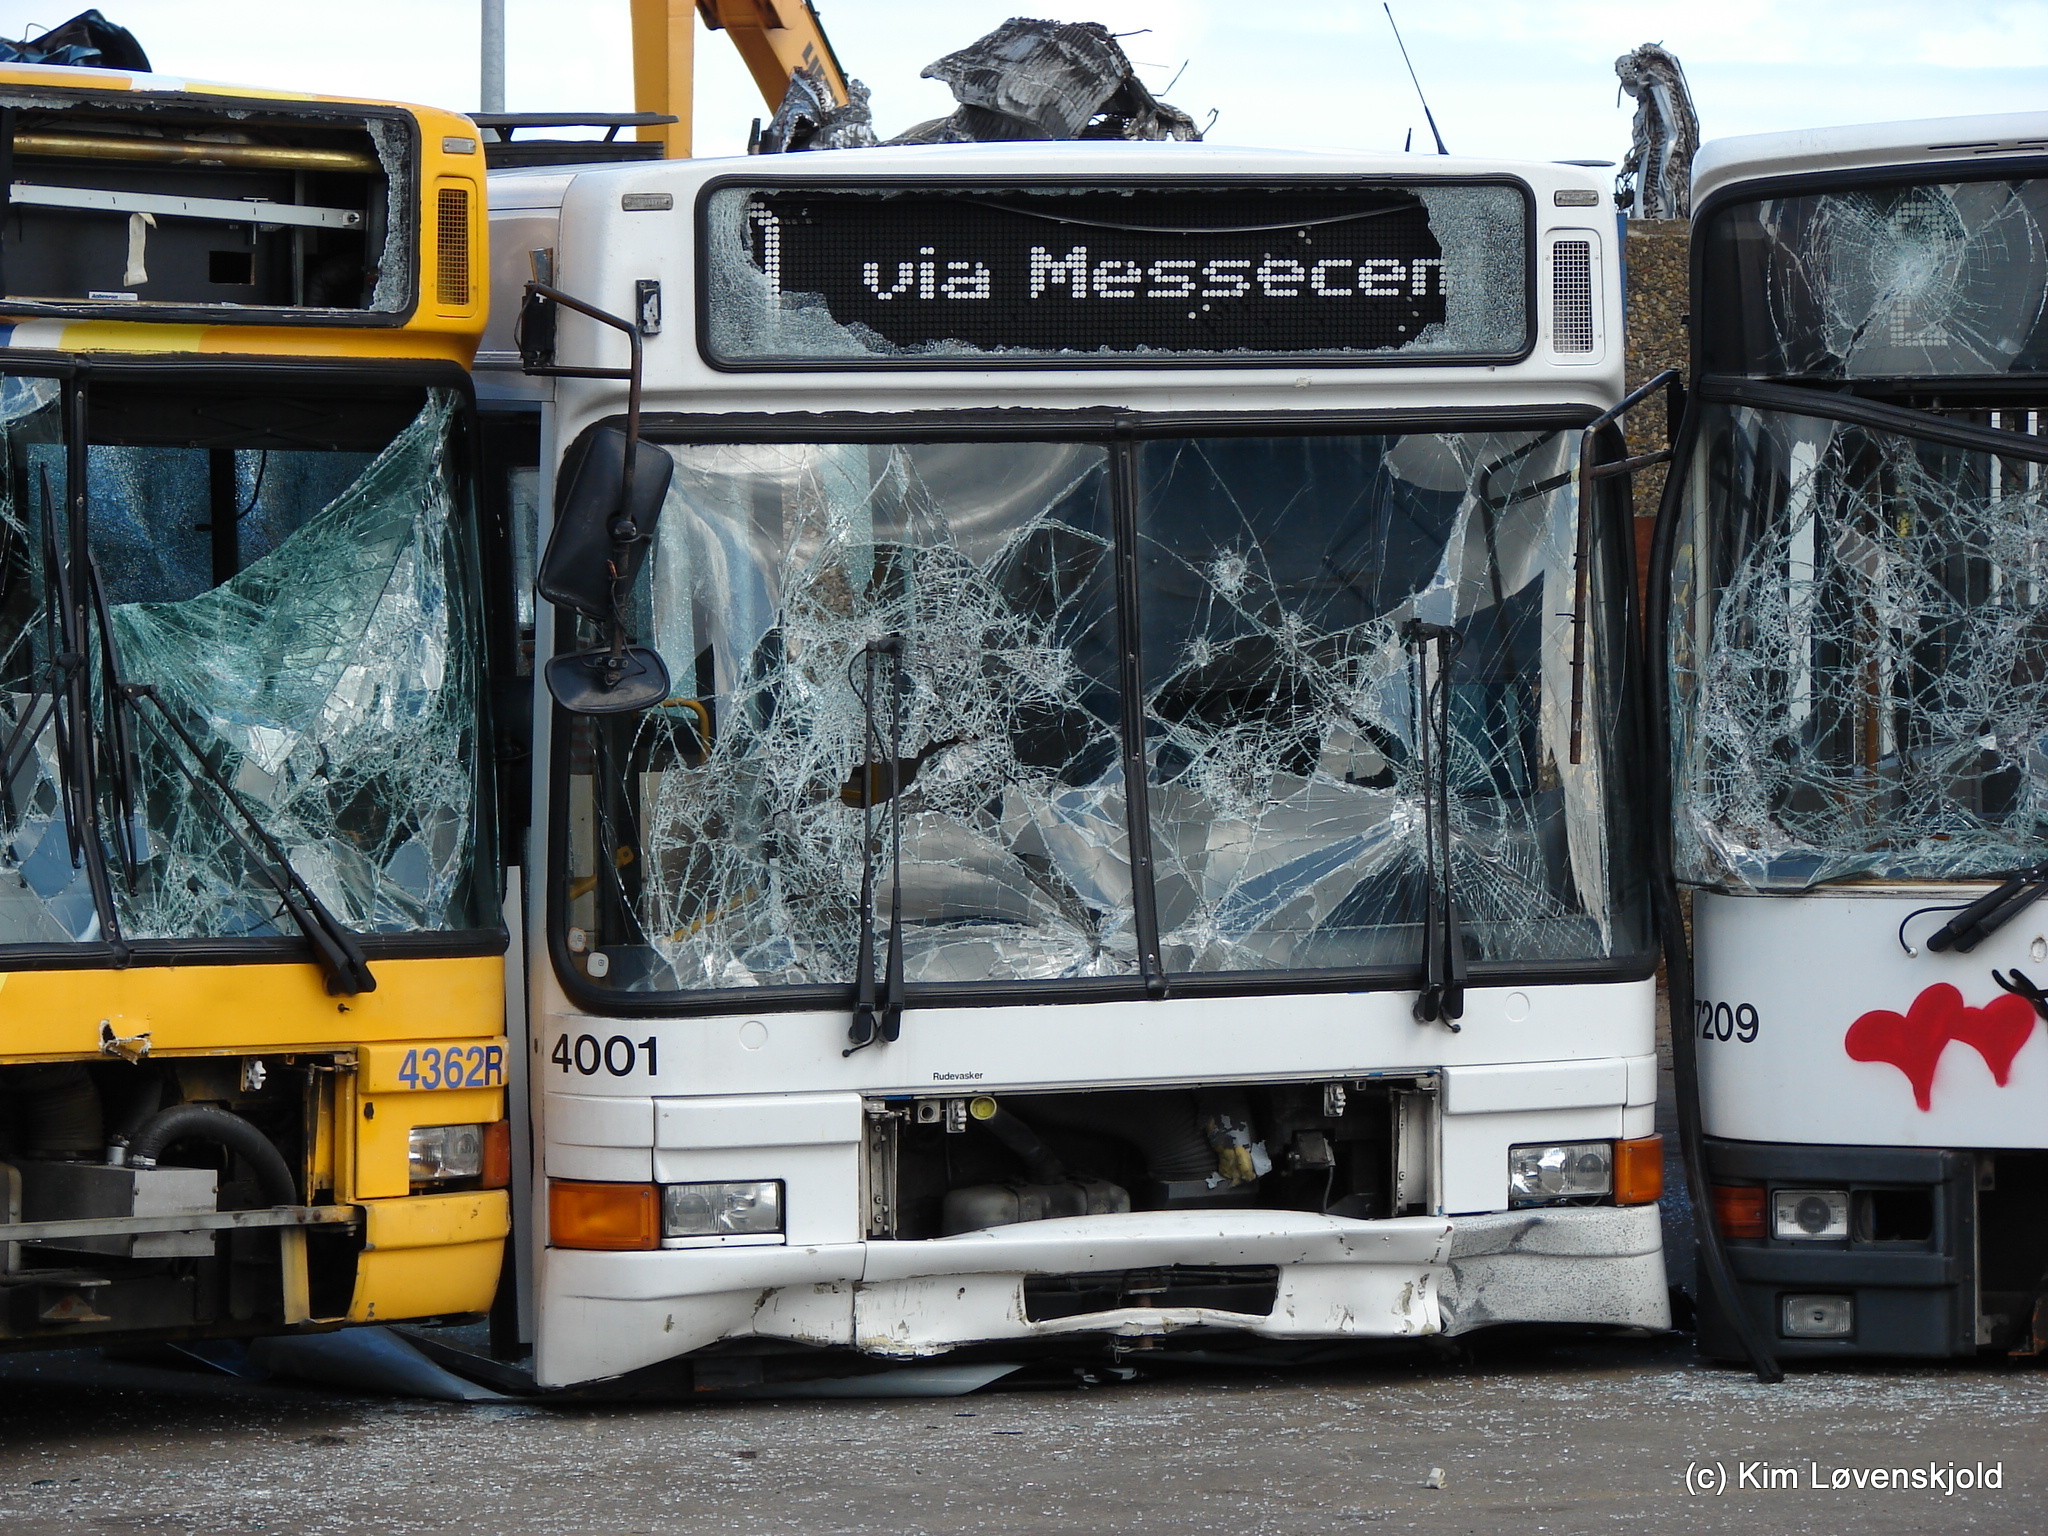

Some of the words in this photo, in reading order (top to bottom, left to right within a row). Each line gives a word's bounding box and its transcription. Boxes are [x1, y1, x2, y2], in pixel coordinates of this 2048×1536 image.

[749, 202, 781, 332] 1
[863, 246, 990, 300] via
[1694, 1000, 1759, 1043] 7209
[398, 1045, 503, 1090] 4362R
[551, 1033, 658, 1077] 4001
[933, 1071, 984, 1081] Rudevasker
